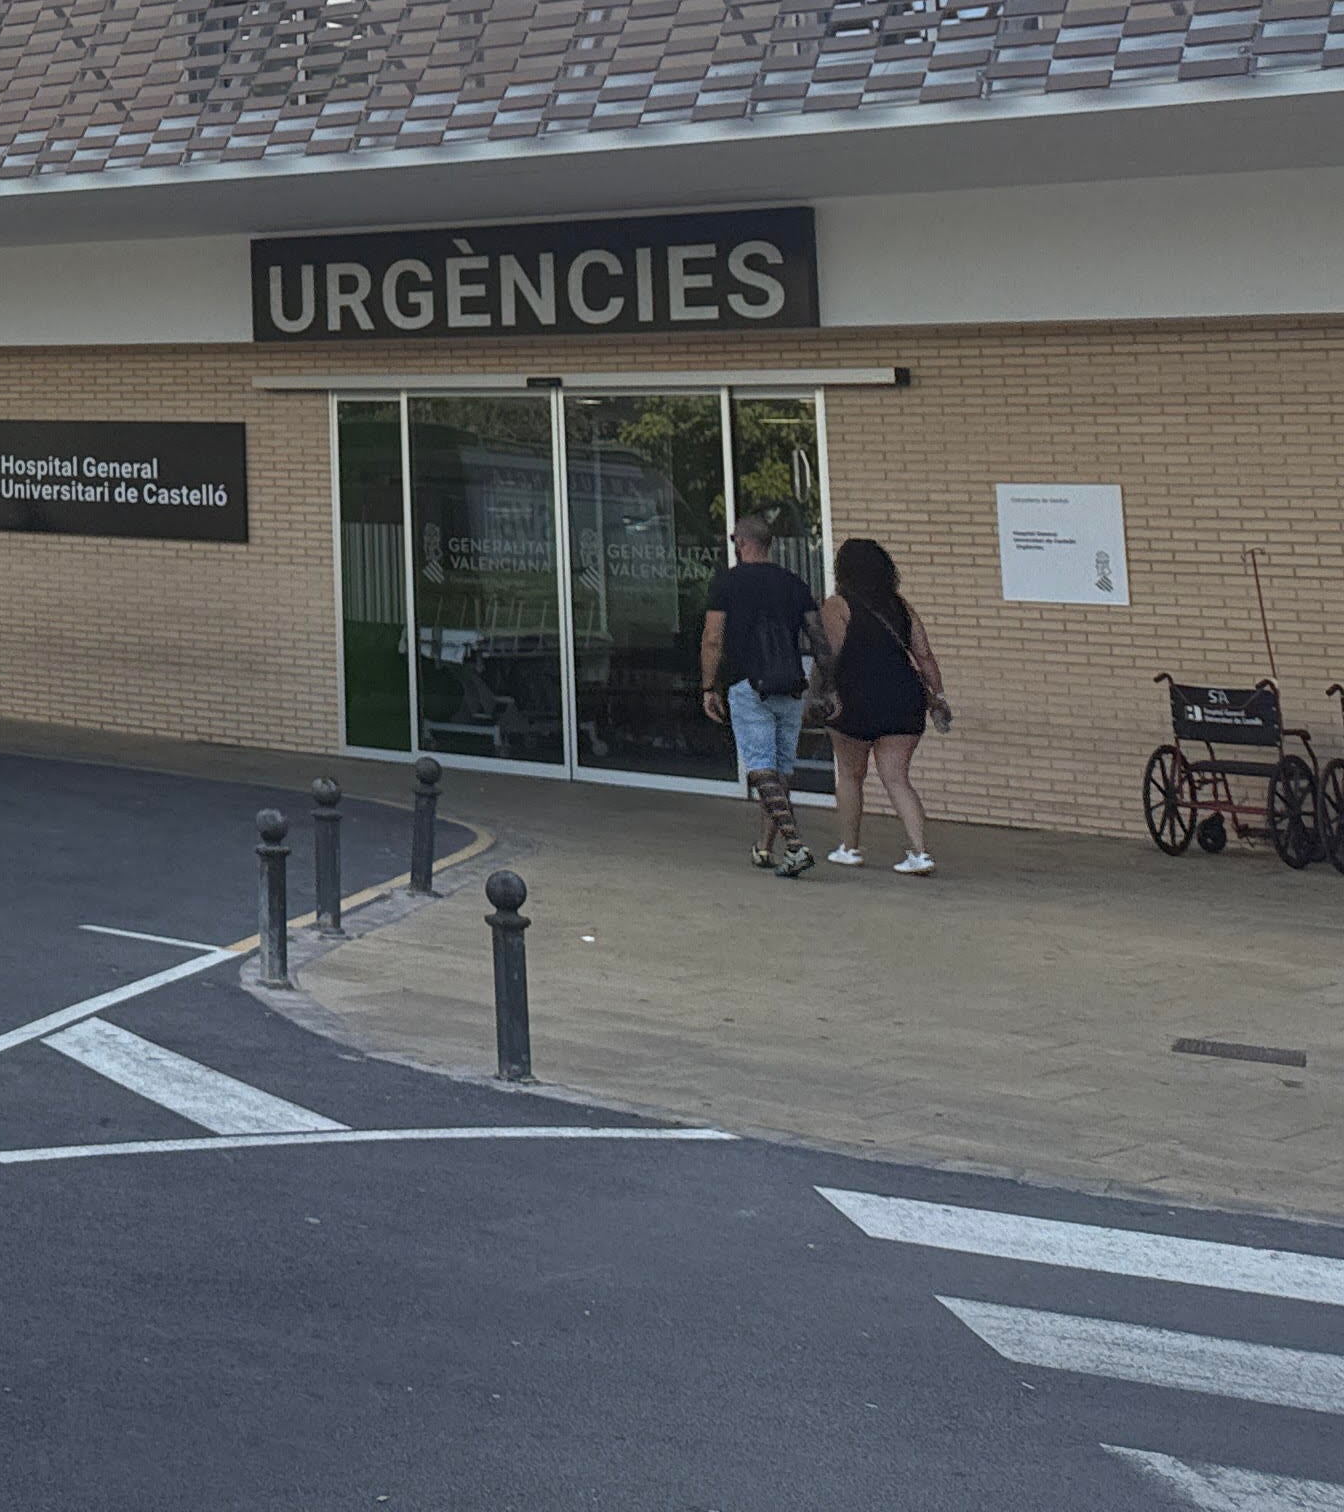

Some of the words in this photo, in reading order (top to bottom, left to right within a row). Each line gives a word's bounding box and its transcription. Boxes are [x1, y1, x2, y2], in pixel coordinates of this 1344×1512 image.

[268, 238, 786, 333] URGÈNCIES
[0, 455, 78, 480] Hospital
[82, 457, 158, 480] General
[0, 479, 109, 502] Universitari
[113, 481, 138, 503] de
[143, 484, 228, 507] Castelló
[448, 537, 555, 555] GENERALITAT
[607, 544, 721, 562] GENERALITAT
